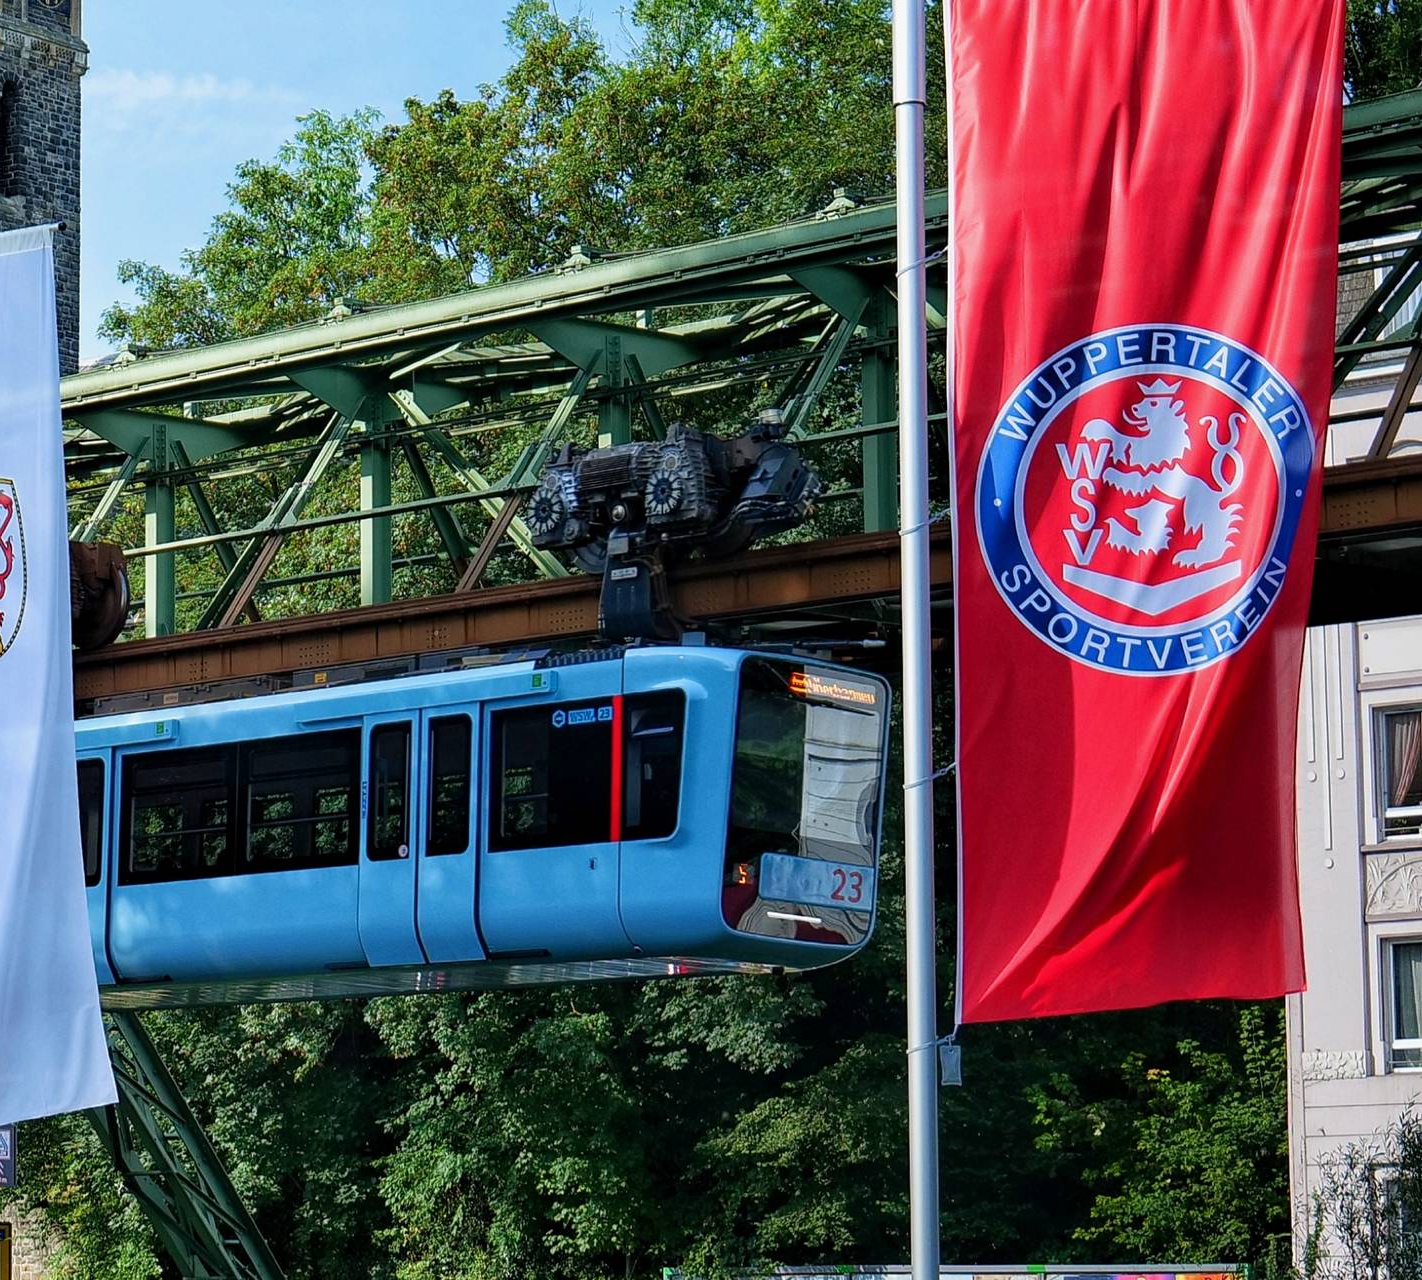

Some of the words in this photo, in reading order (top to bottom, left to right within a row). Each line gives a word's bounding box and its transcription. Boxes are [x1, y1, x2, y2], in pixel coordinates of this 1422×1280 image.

[999, 331, 1304, 442] WUPPERTALER
[1001, 557, 1288, 670] SPORTVEREIN
[599, 707, 611, 719] 23
[830, 868, 863, 903] 23
